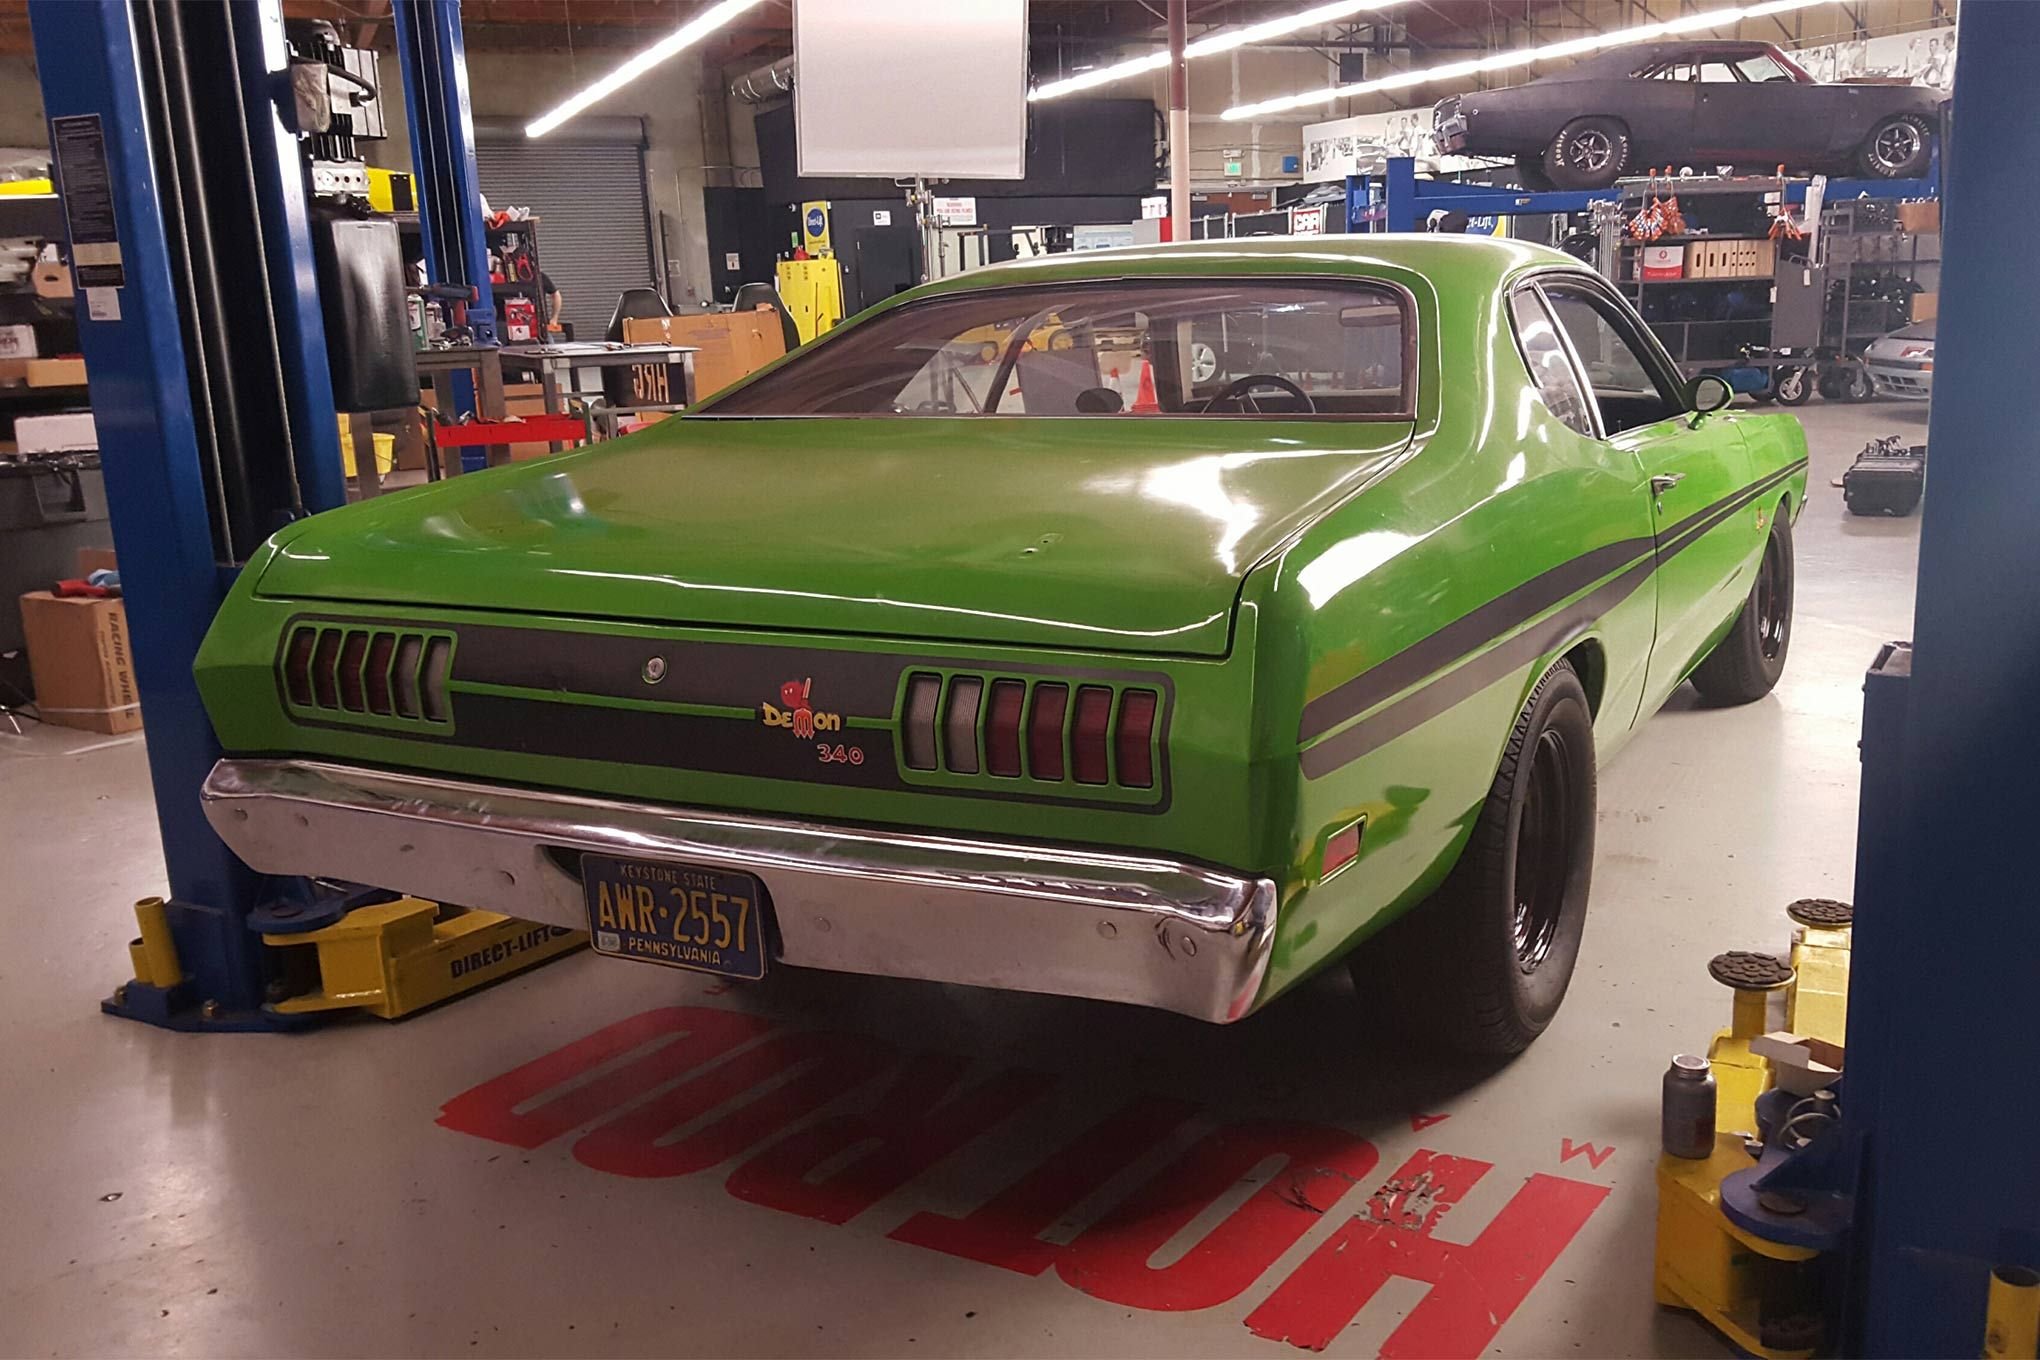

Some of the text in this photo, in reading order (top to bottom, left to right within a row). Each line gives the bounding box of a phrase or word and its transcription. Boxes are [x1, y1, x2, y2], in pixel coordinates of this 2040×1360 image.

[1294, 212, 1320, 231] CAR
[108, 612, 126, 666] RACING
[816, 743, 865, 766] 340
[619, 863, 717, 891] KEYSTONE STATE
[450, 923, 552, 979] DIRECT-LIFT
[627, 936, 722, 967] PENNSYLVANIA
